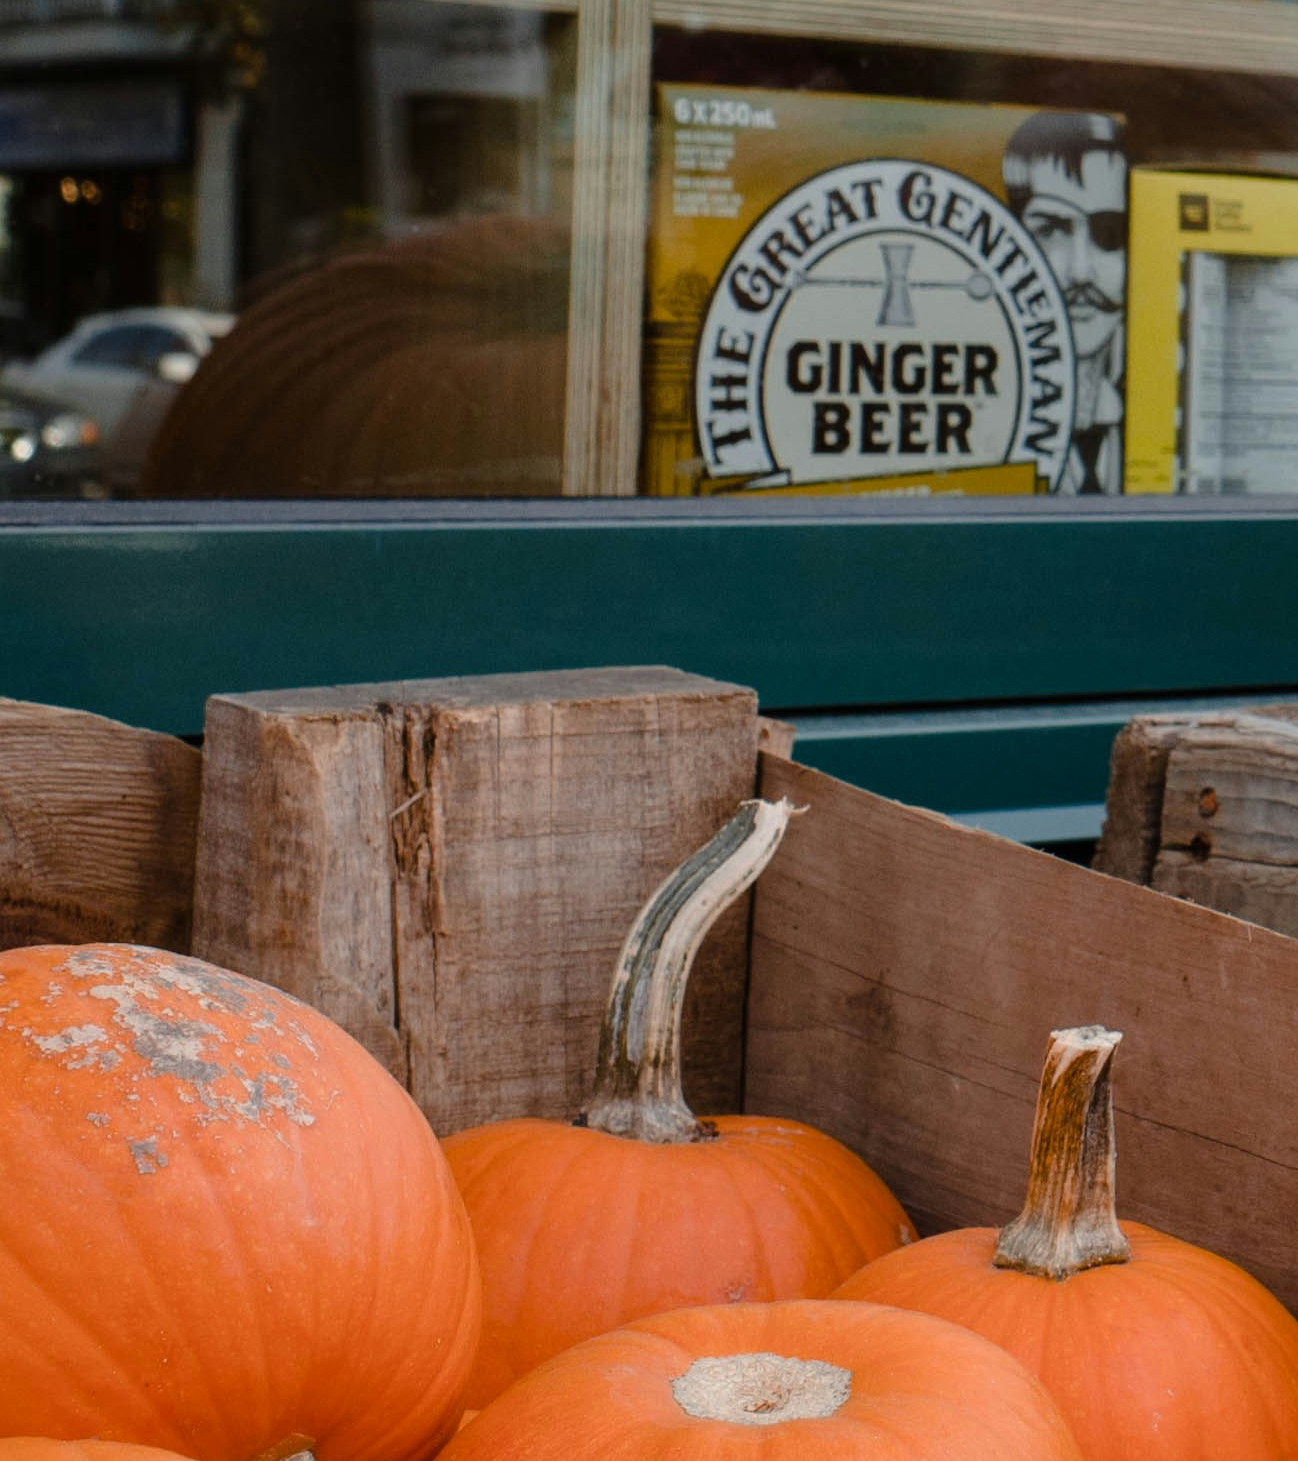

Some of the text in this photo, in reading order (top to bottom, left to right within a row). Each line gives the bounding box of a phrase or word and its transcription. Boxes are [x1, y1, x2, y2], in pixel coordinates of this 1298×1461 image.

[729, 177, 883, 315] GREAT
[898, 169, 1066, 461] GENTLEMAN
[709, 325, 756, 467] THE
[785, 340, 1000, 398] GINGER
[811, 400, 974, 456] BEER
